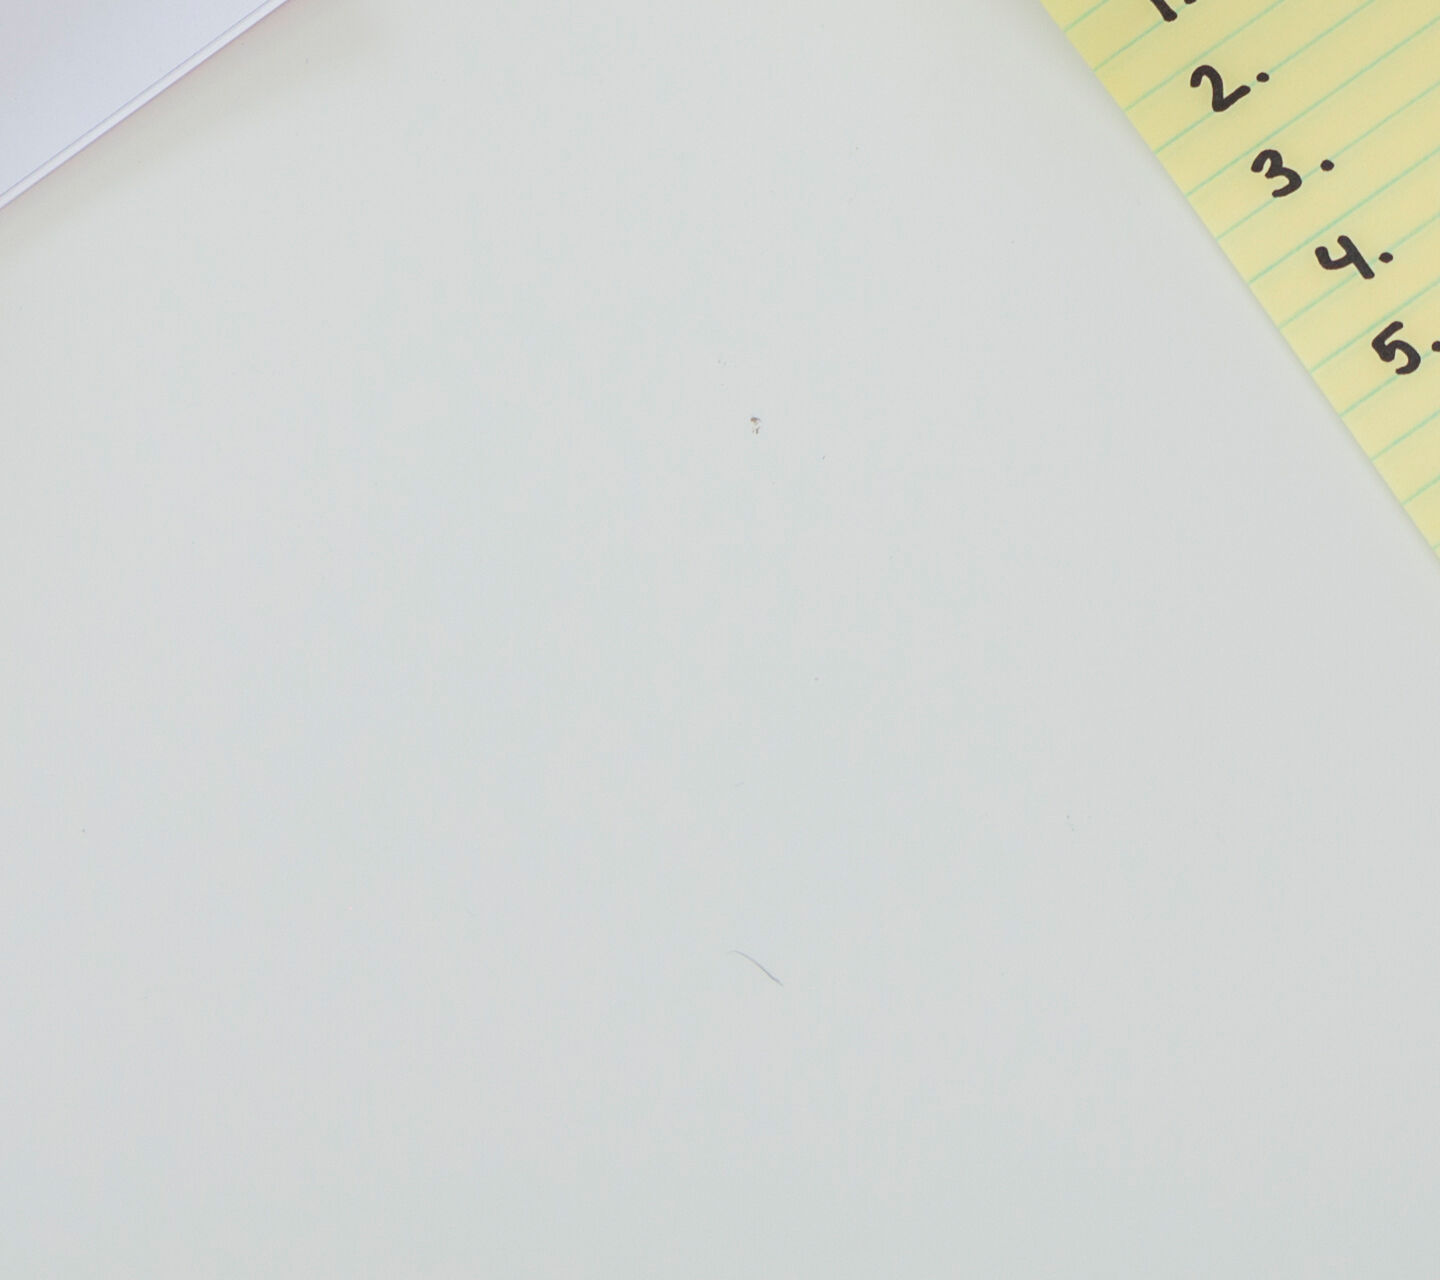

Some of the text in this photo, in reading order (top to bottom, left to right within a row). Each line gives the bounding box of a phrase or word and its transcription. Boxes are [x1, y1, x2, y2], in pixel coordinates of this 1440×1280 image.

[1189, 64, 1270, 113] 2.
[1250, 148, 1335, 199] 3.
[1314, 235, 1394, 280] 4.
